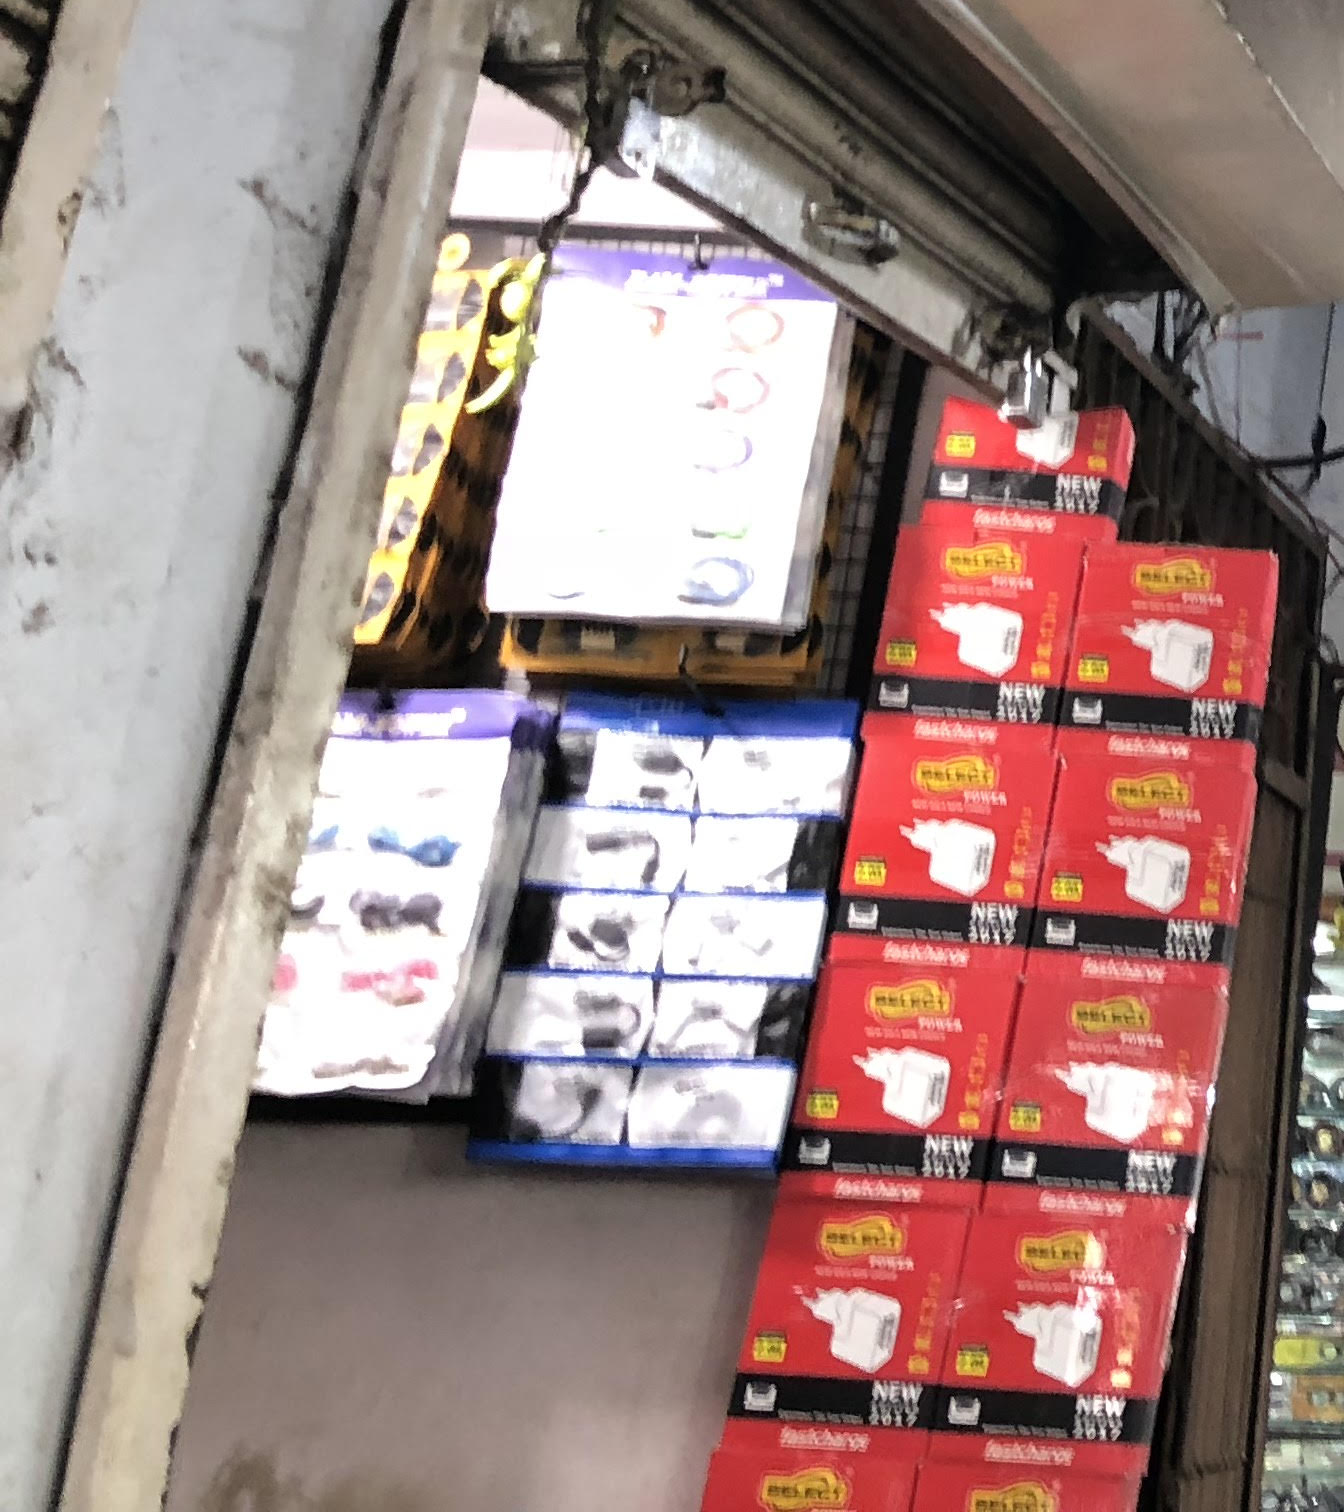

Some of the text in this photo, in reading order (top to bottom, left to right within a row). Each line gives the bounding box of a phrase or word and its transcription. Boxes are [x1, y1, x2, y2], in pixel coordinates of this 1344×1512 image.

[1056, 473, 1102, 493] NEW
[1000, 681, 1046, 700] NEW
[1191, 697, 1238, 716] NEW
[970, 901, 1019, 921] NEW
[1166, 918, 1215, 939] NEW
[924, 1133, 974, 1154] NEW
[872, 1380, 923, 1401] NEW
[1075, 1394, 1127, 1415] NEW
